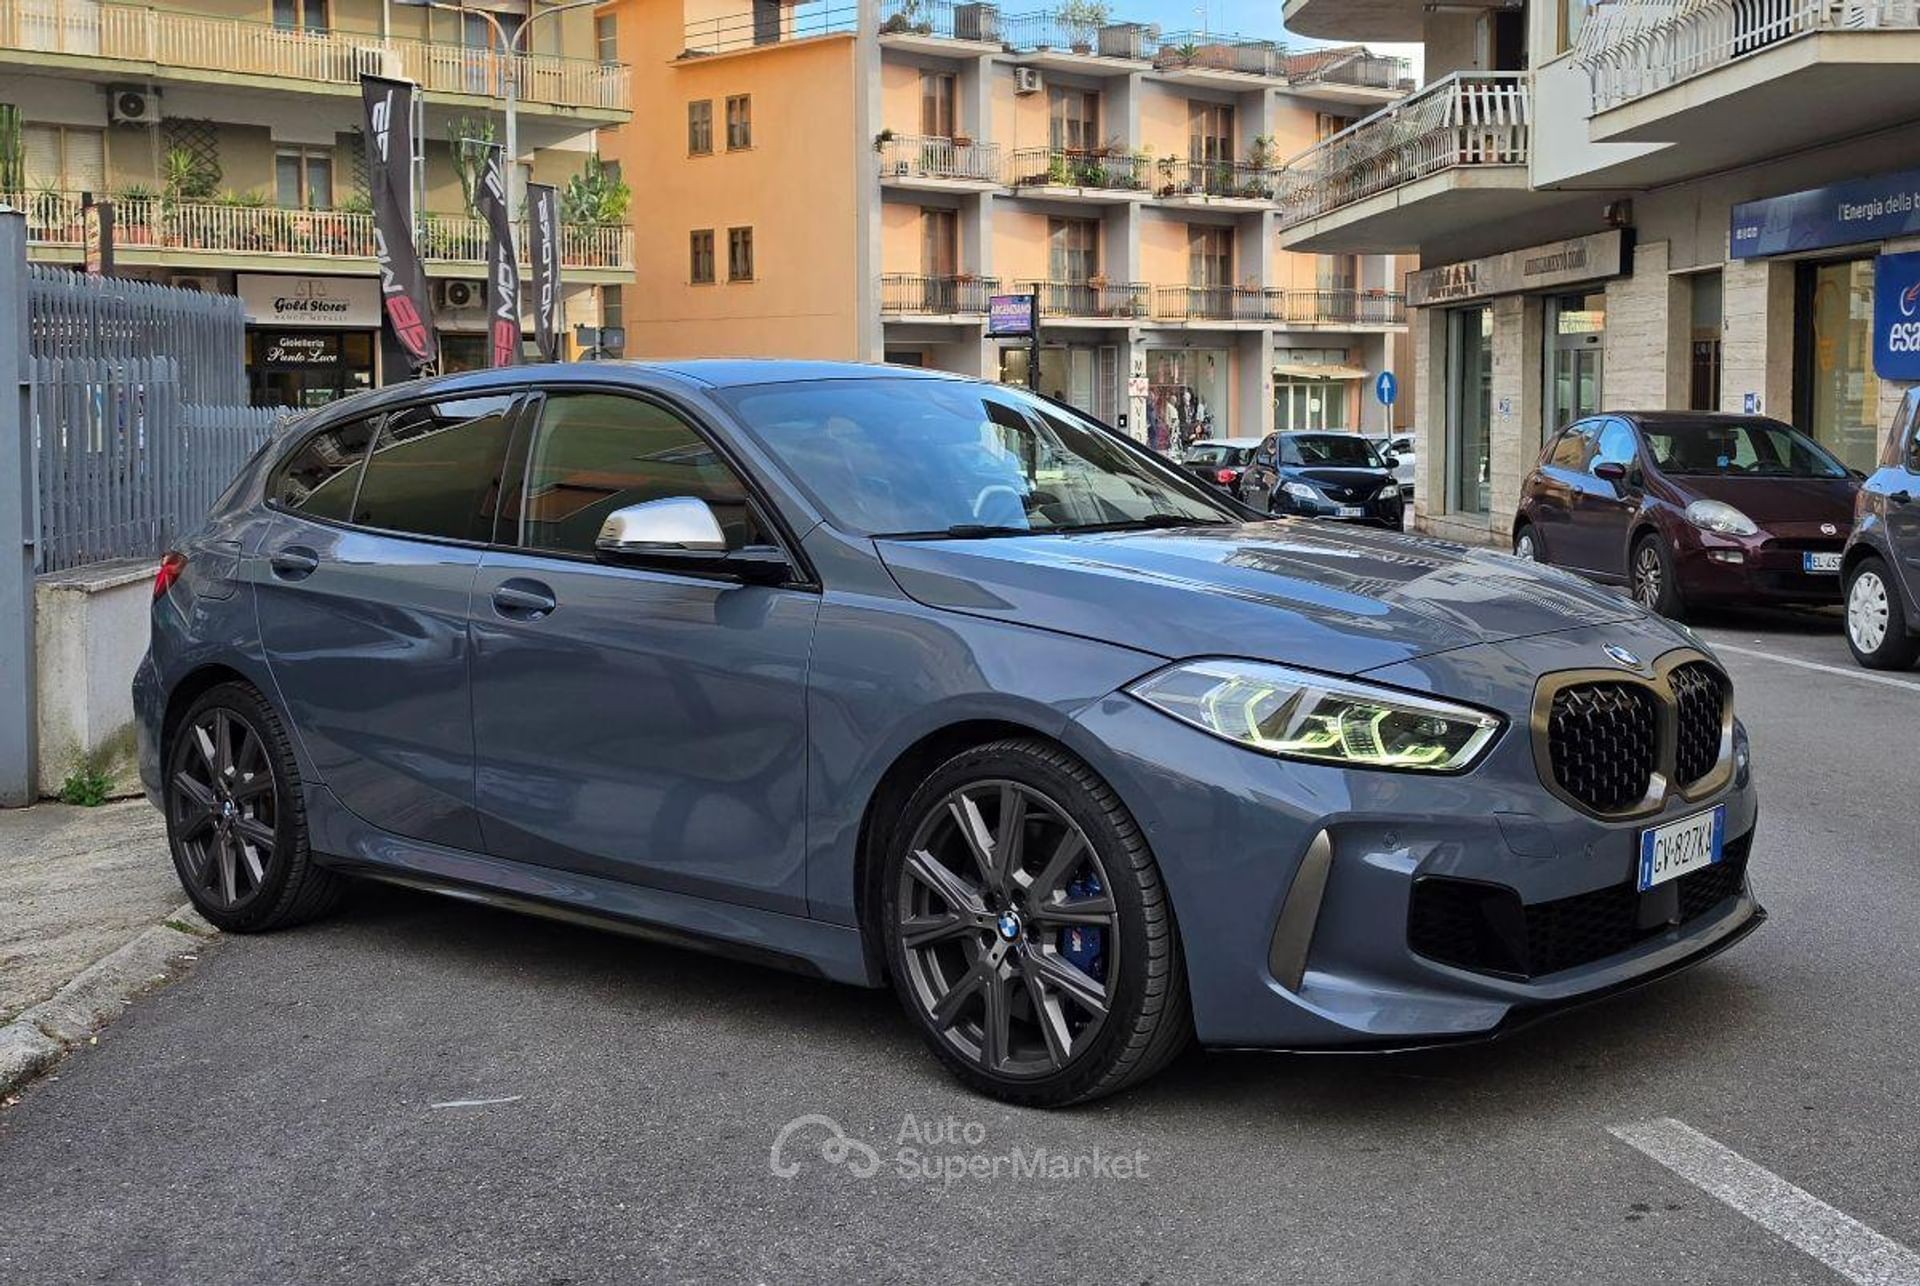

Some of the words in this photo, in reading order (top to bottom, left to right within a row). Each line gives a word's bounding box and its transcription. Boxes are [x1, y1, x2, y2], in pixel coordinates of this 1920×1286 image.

[1838, 198, 1883, 221] l'Energia
[1885, 192, 1911, 214] della
[274, 297, 307, 313] Gold
[310, 300, 347, 312] Stores
[267, 347, 305, 361] Punto
[307, 348, 338, 362] Luce
